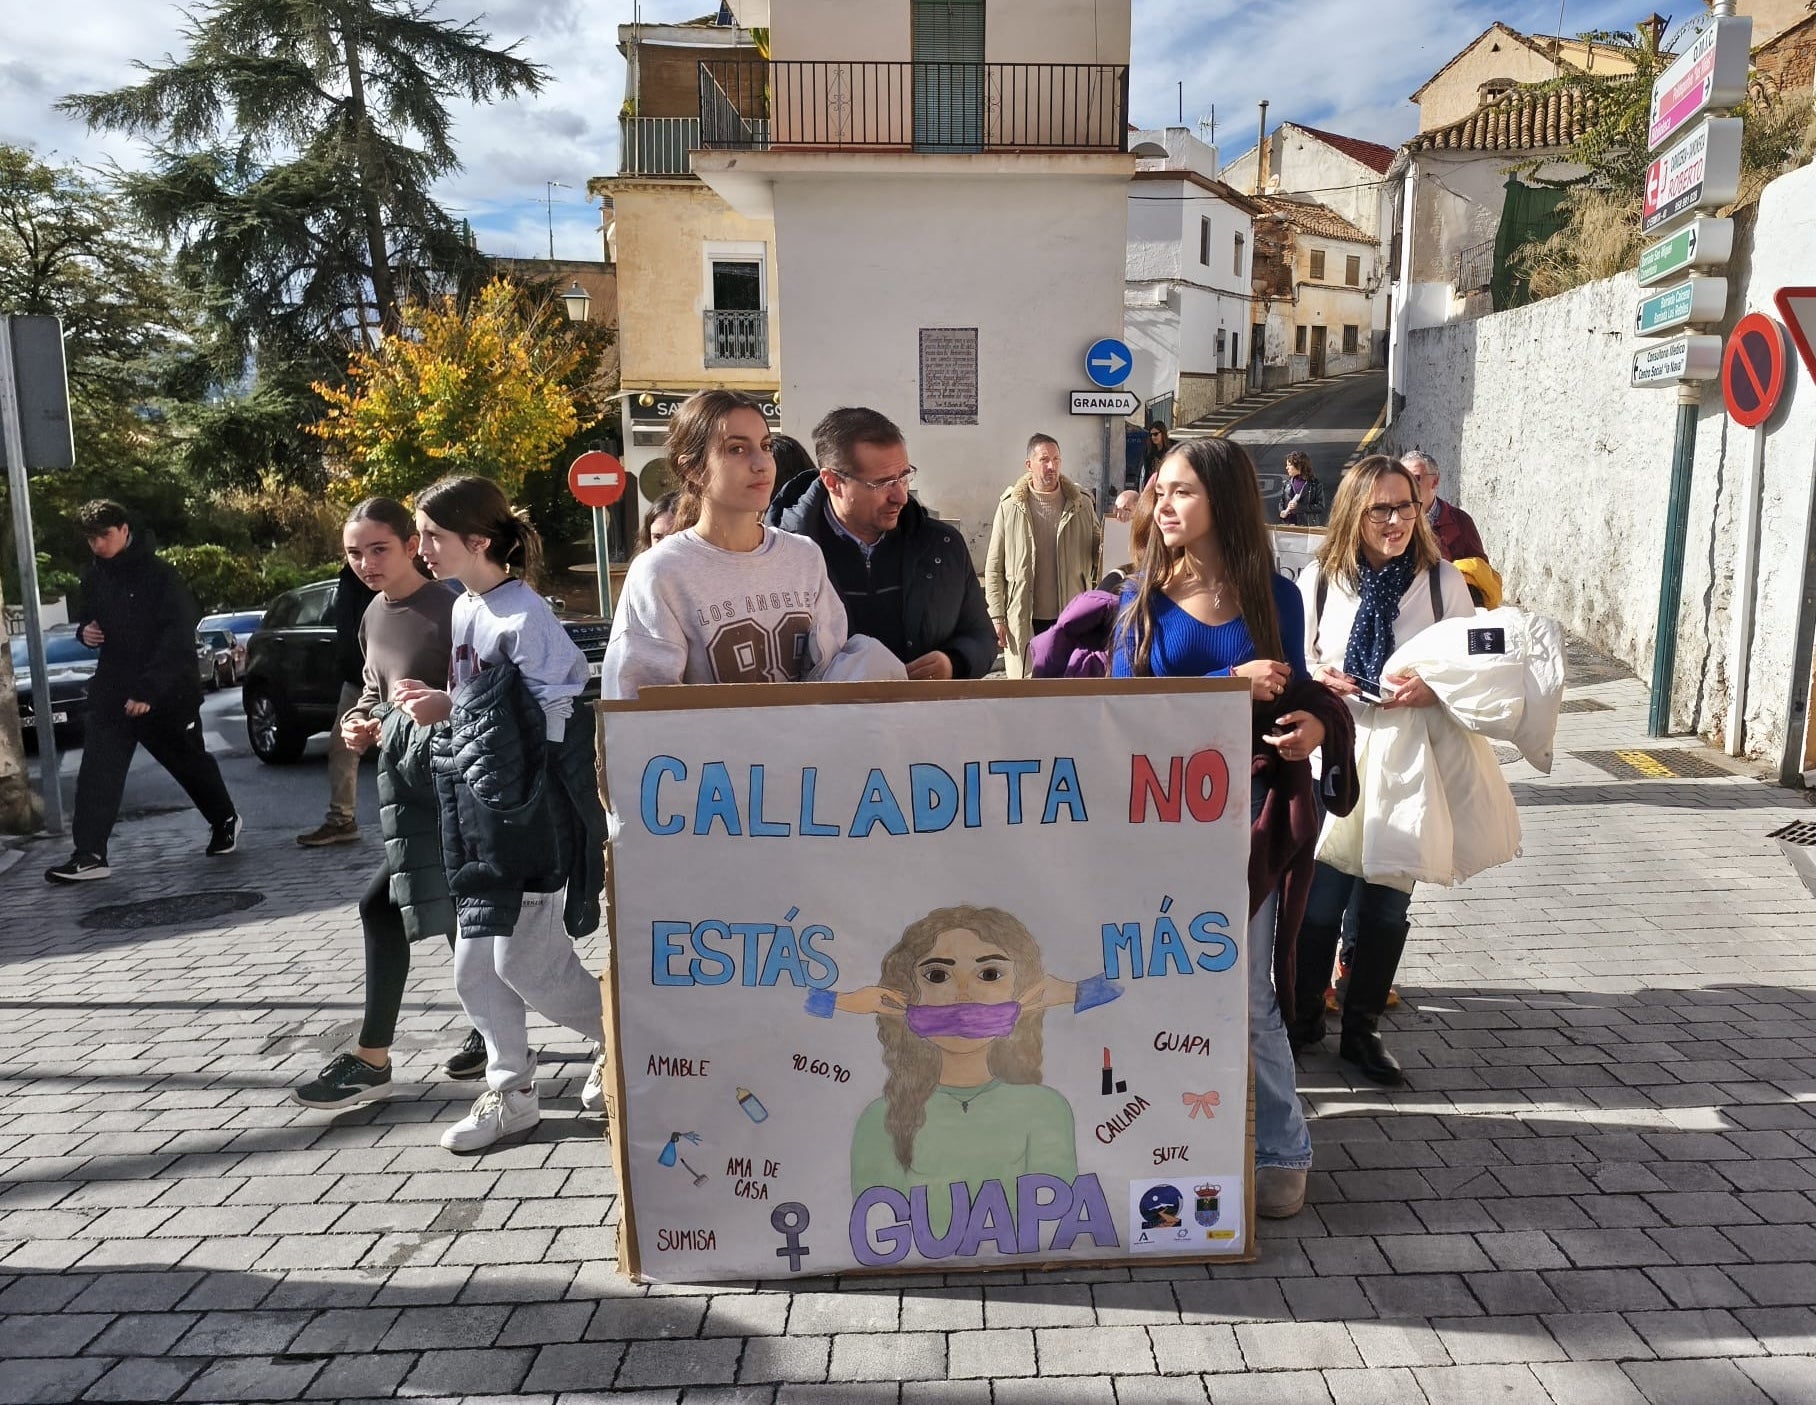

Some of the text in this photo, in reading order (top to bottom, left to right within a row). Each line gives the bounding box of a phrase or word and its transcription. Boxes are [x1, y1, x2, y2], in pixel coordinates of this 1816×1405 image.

[1668, 157, 1703, 198] ROBERTO
[1073, 398, 1130, 408] GRANADA
[697, 591, 817, 626] LOS ANGELE
[640, 748, 1230, 838] CALLADITA NO
[652, 894, 1239, 990] ESTÁS MÁS
[1153, 1031, 1211, 1056] GUAPA
[647, 1054, 710, 1077] AMABLE
[1095, 1095, 1151, 1144] CALLADA
[726, 1157, 781, 1178] AMA DE
[1152, 1145, 1189, 1166] SUTIL
[734, 1179, 769, 1200] CASA
[849, 1172, 1121, 1267] GUAPA
[657, 1228, 717, 1251] SUMISA
